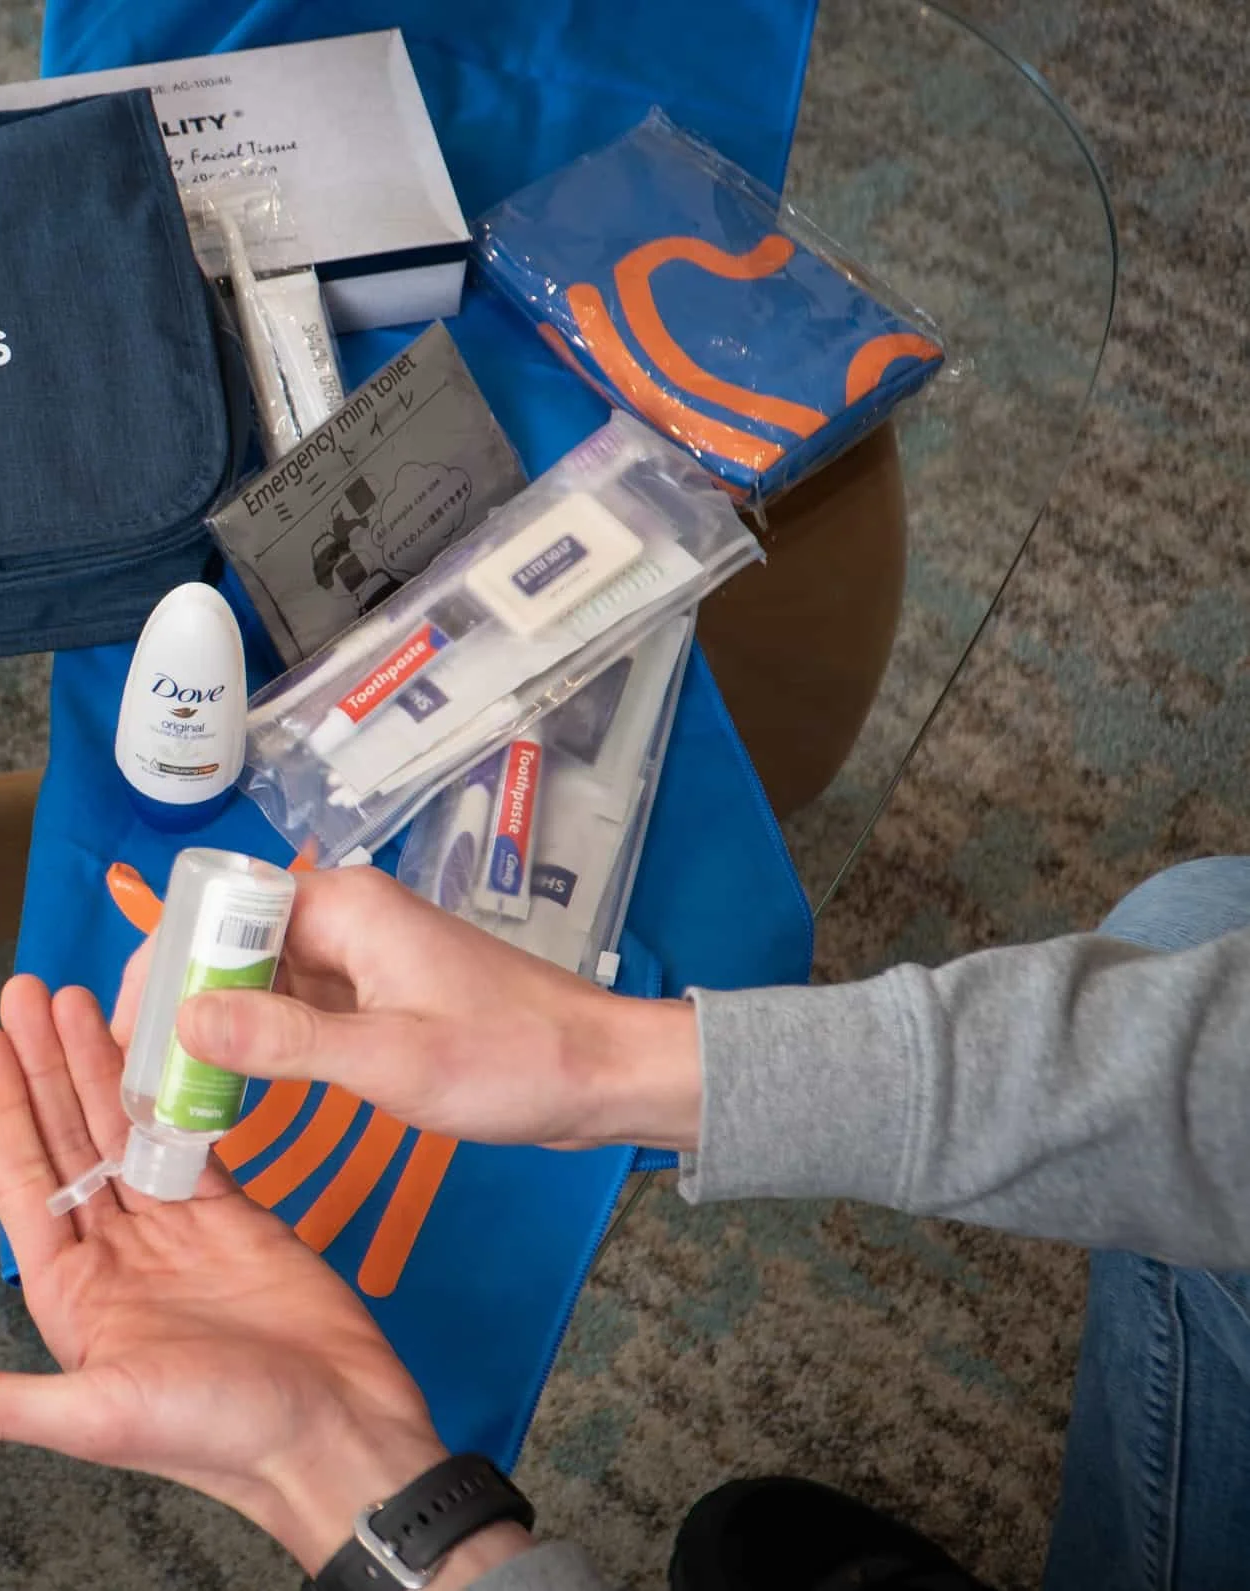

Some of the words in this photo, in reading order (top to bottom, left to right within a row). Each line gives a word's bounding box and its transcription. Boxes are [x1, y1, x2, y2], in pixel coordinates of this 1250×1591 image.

[161, 113, 226, 137] LITY
[190, 143, 244, 165] Facial
[247, 140, 298, 156] Tissue
[241, 427, 341, 518] Emergency
[335, 392, 375, 435] mini
[370, 352, 418, 399] toilet
[151, 672, 226, 704] Dove
[346, 638, 428, 711] Toothpaste
[161, 720, 205, 734] original
[508, 749, 536, 835] Toothpaste
